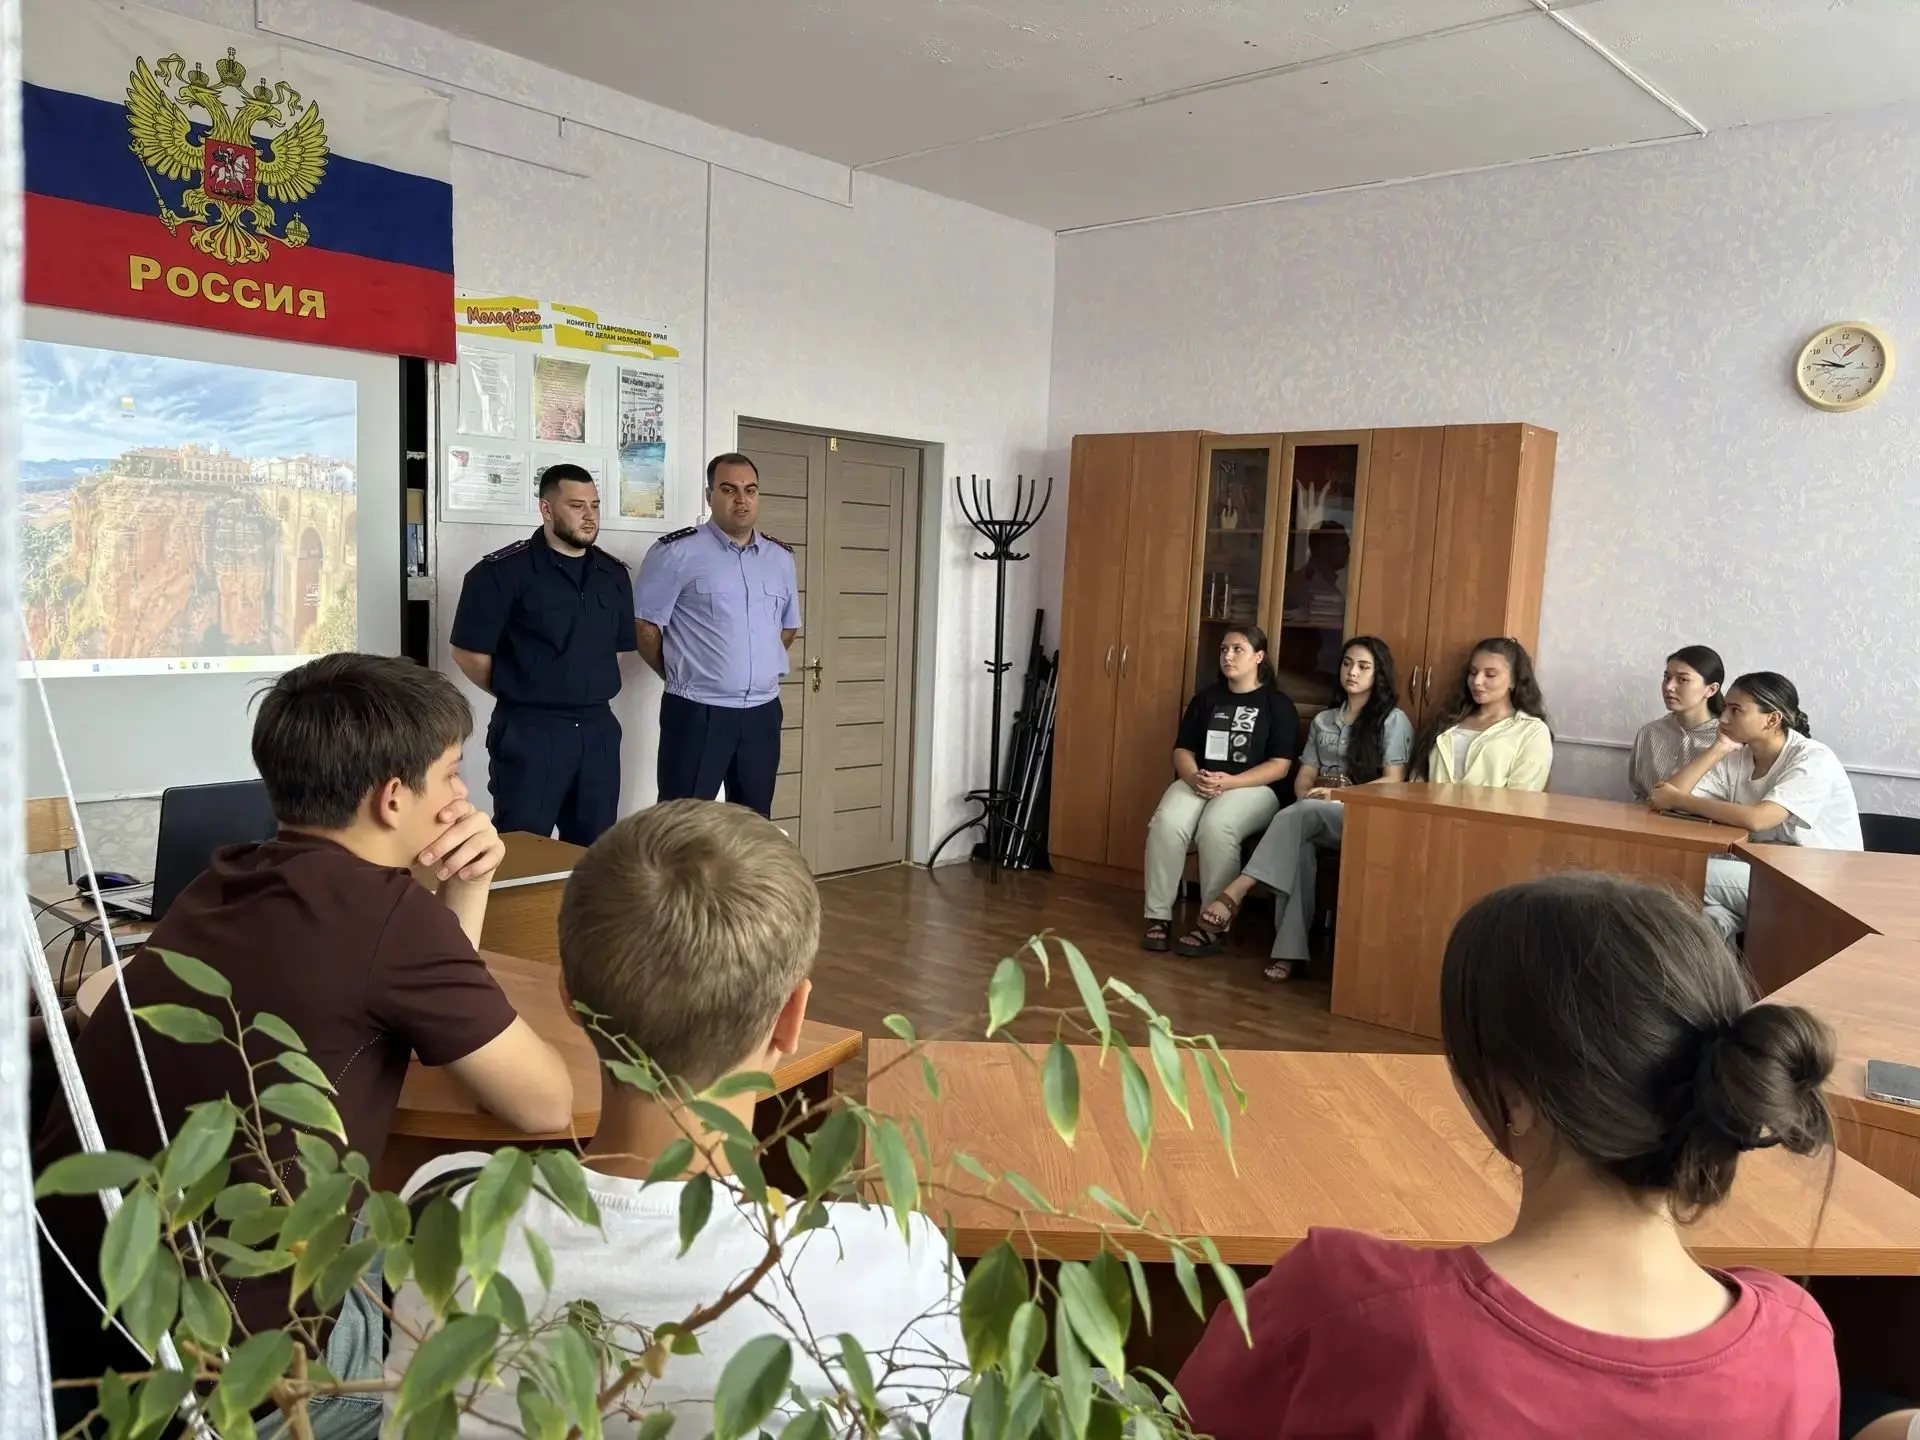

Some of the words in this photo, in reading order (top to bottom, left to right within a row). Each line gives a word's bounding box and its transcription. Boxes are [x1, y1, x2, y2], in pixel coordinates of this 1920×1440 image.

[467, 306, 541, 332] Молодёжь
[566, 318, 594, 328] КОМИТЕТ
[596, 323, 652, 338] СТАВРОПОЛЬСКОГО
[652, 332, 667, 340] КРАЯ
[595, 332, 616, 340] ДЕЛАМ
